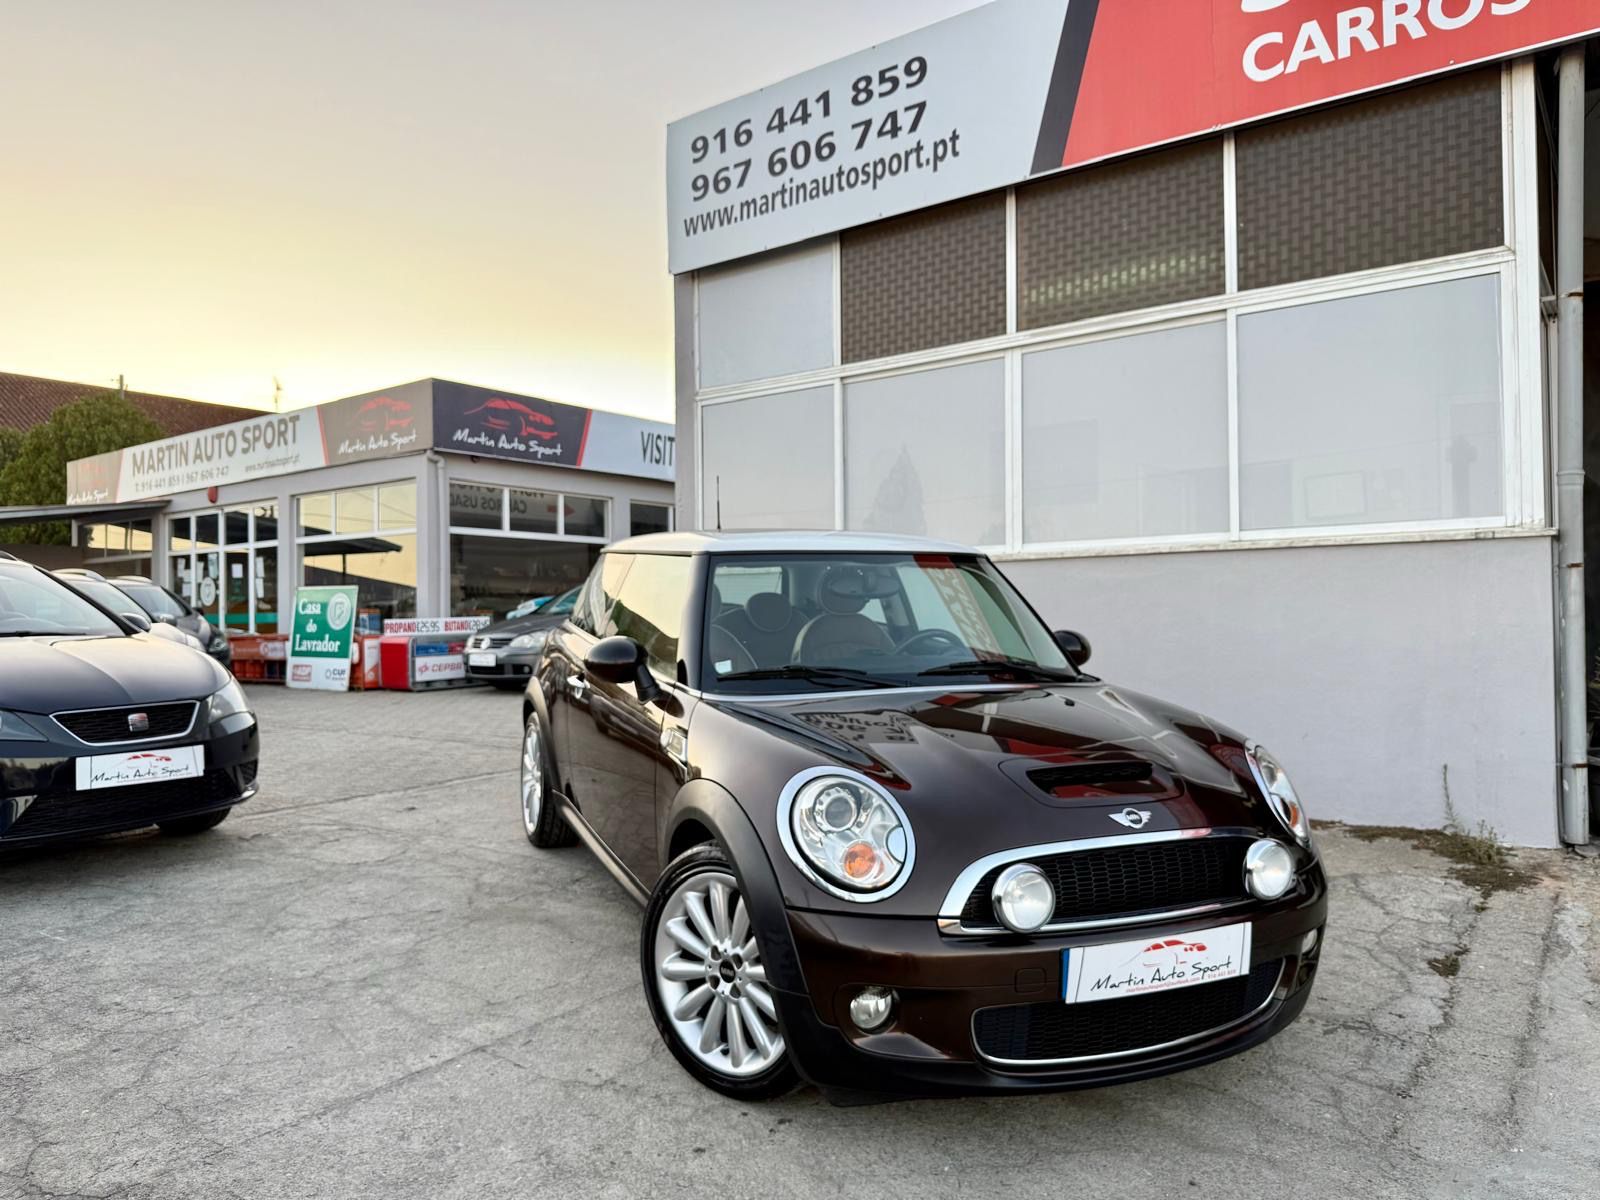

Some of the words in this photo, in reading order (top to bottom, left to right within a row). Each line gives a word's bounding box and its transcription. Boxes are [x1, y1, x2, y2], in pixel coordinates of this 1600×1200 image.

[1242, 0, 1533, 82] CARRO
[691, 119, 753, 163] 916
[766, 90, 831, 134] 441
[851, 55, 928, 107] 859
[691, 158, 752, 202] 967
[768, 131, 836, 177] 606
[851, 100, 927, 151] 747
[683, 128, 960, 237] www.martinautosport.pt
[132, 440, 188, 477] MARTIN
[193, 430, 236, 464] AUTO
[241, 415, 300, 454] SPORT
[338, 440, 366, 456] Martin
[368, 435, 389, 450] Auto
[390, 431, 417, 452] Sport
[453, 428, 495, 448] Martin
[498, 434, 526, 450] Auto
[528, 439, 563, 458] Sport
[641, 431, 675, 466] VISIT
[298, 598, 321, 615] Casa
[306, 619, 317, 632] do
[384, 621, 416, 633] PROPANO
[444, 620, 468, 632] BUTANO
[295, 633, 340, 653] Lavrador
[92, 770, 129, 783] Martin
[133, 768, 158, 779] Auto
[161, 764, 189, 778] Sport
[1091, 970, 1144, 992] Martin
[1150, 967, 1185, 983] Auto
[1192, 955, 1232, 980] Sport
